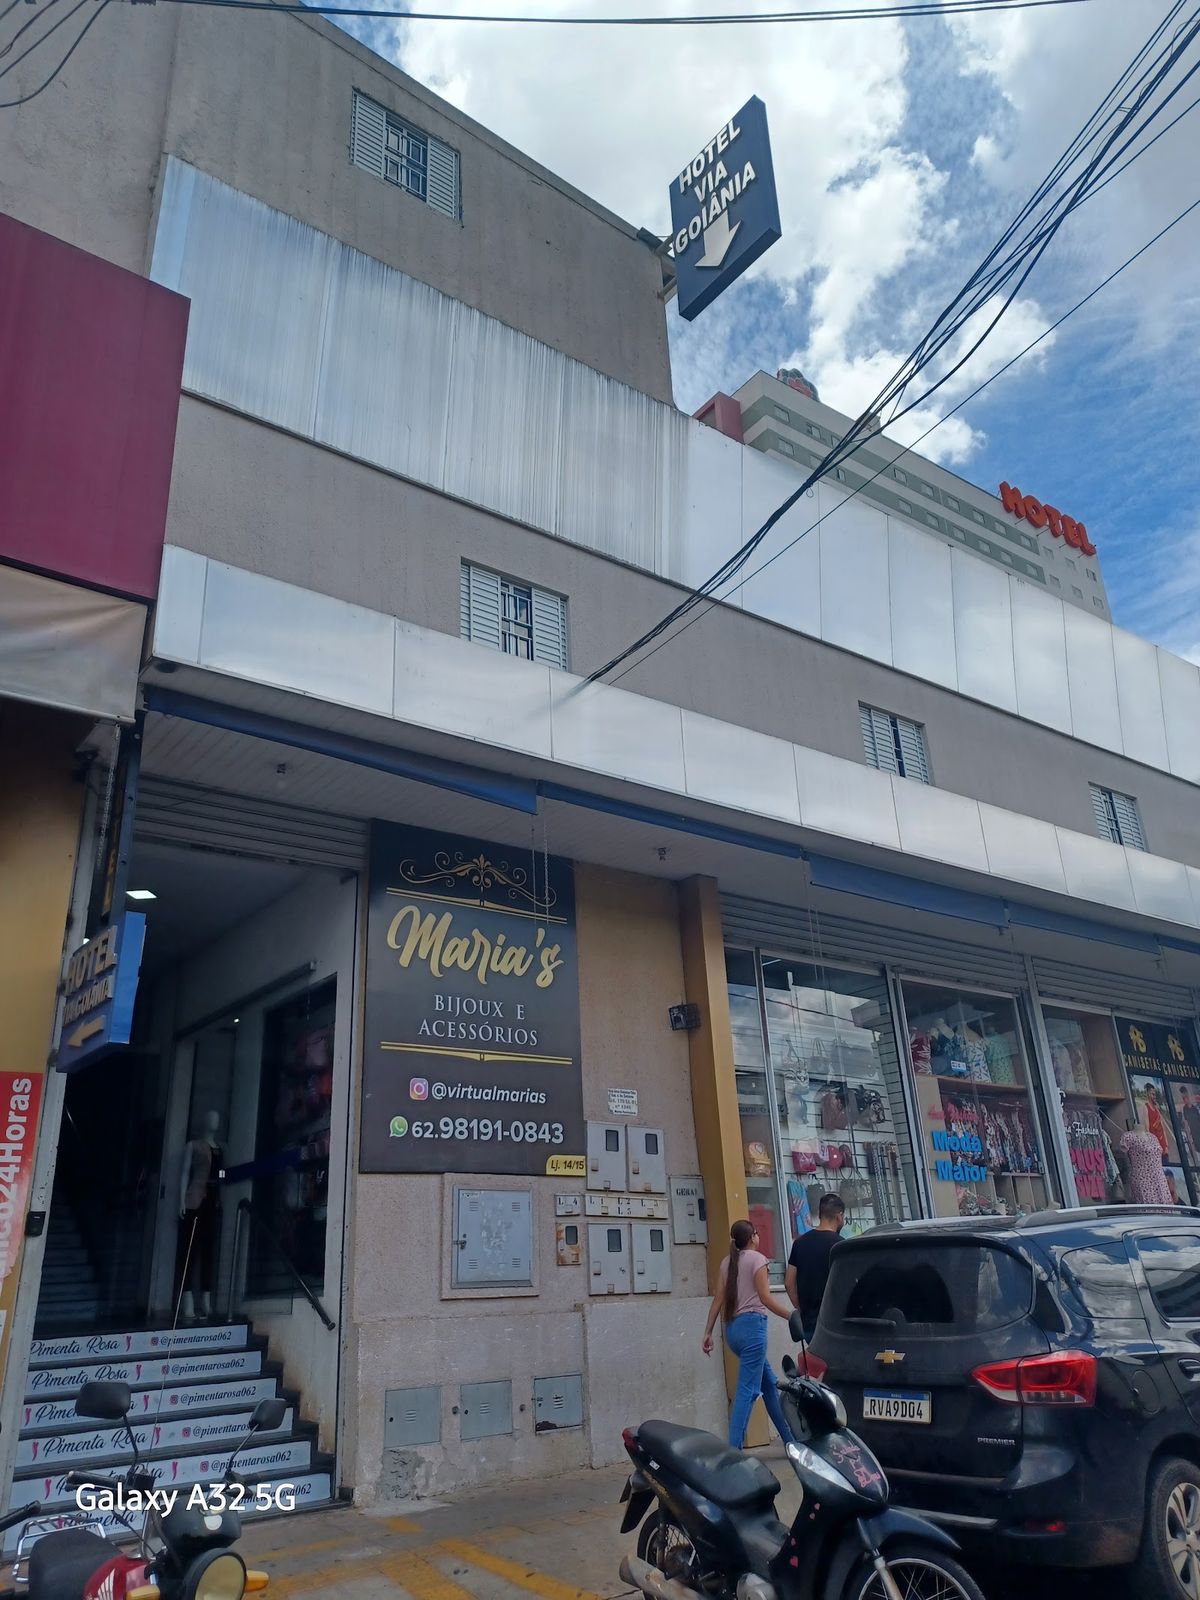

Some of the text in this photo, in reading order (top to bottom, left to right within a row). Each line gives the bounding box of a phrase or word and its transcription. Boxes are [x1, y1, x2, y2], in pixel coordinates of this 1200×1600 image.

[679, 119, 741, 194] HOTEL
[692, 160, 728, 203] VIA
[675, 160, 757, 255] GOIÂNIA
[999, 481, 1096, 556] HOTEL
[66, 925, 118, 997] HOTEL
[386, 905, 565, 988] Maria's
[434, 994, 525, 1021] BIJOUX E
[418, 1019, 539, 1047] ACESSÓRIOS
[431, 1081, 547, 1105] @virtualmarias
[411, 1116, 565, 1144] 62.98191-0843
[932, 1128, 983, 1153] Moda
[550, 1159, 585, 1171] Lj. 14/15
[31, 1331, 232, 1357] Pimenta Rosa @pimentarosa062
[31, 1358, 245, 1391] Pimenta Rosa @pimentarosa062
[35, 1386, 257, 1425] Pime @pimentarosa062
[43, 1433, 106, 1458] Pimenta
[192, 1422, 251, 1438] @pimentaros
[977, 1436, 1016, 1446] PREMIER
